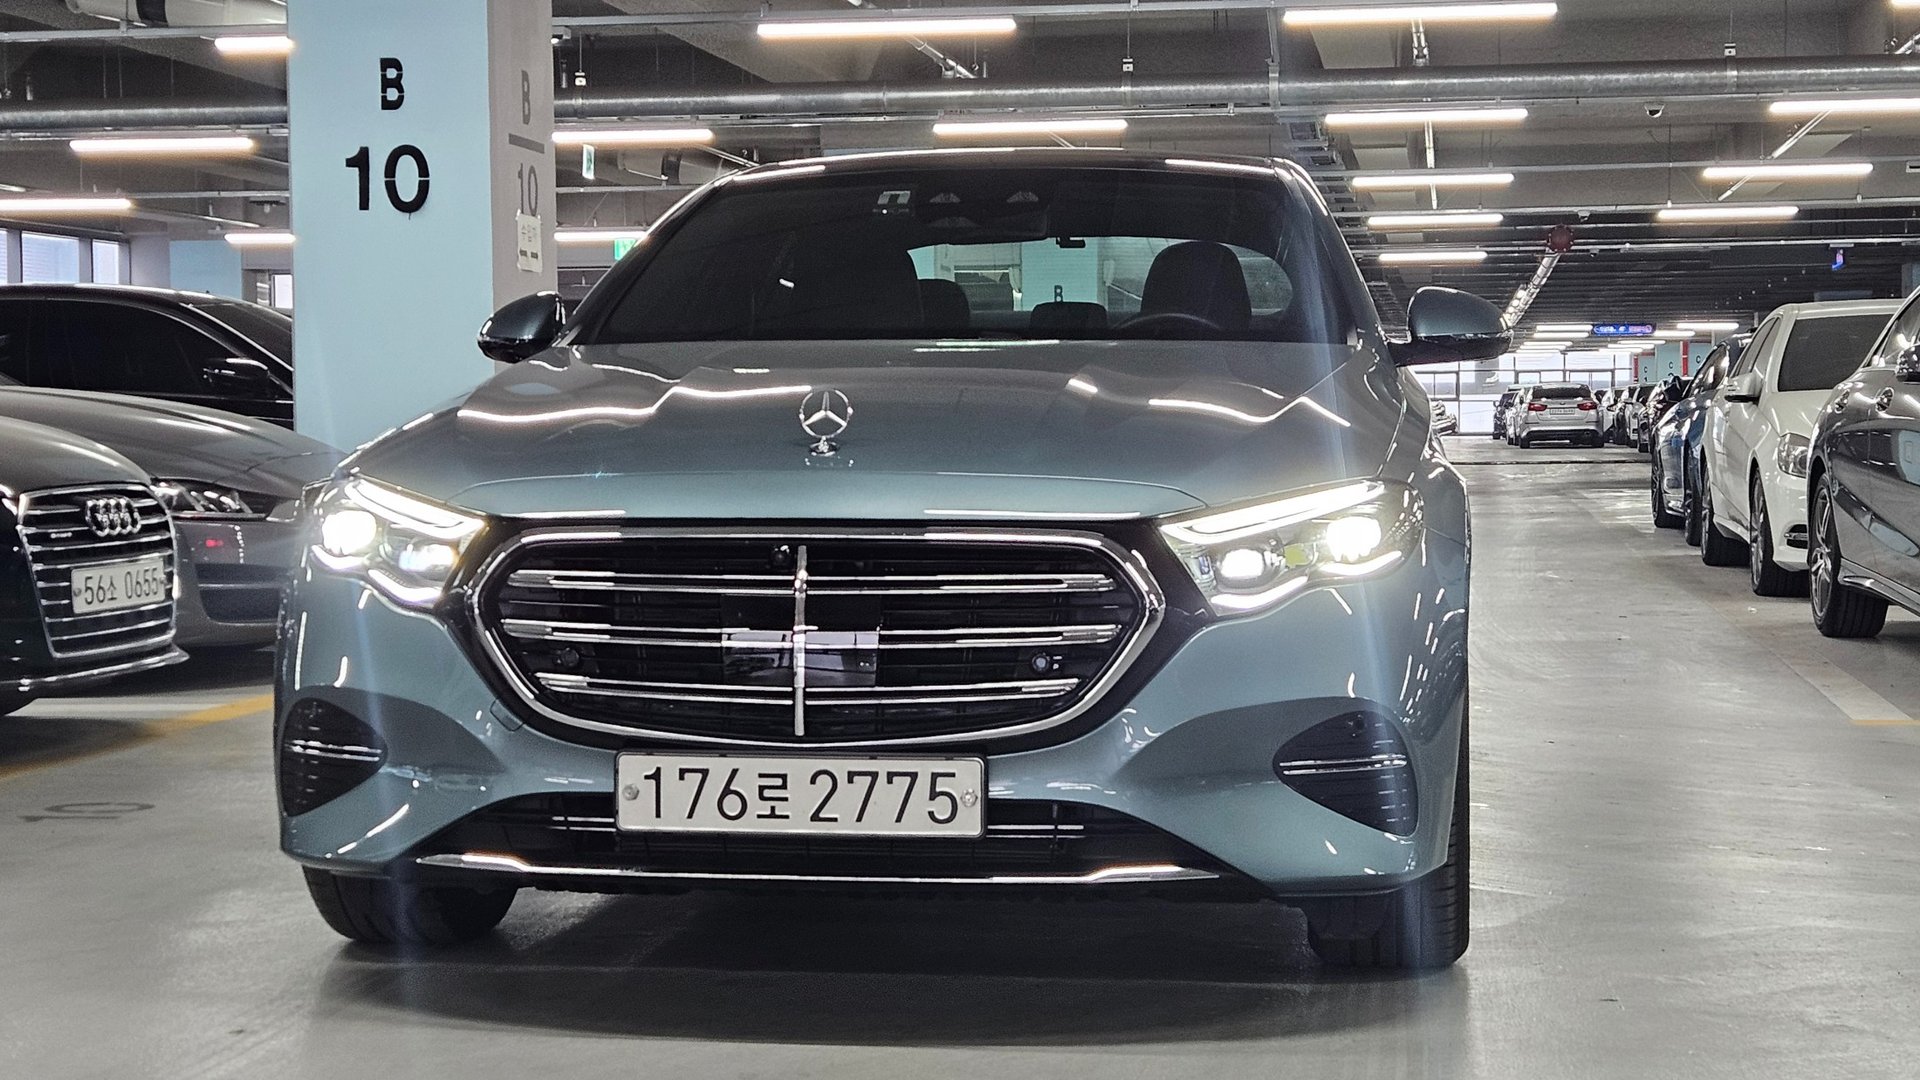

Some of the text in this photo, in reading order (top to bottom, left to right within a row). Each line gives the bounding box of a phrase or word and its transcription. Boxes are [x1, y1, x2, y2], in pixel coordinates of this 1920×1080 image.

[379, 57, 405, 110] B
[521, 70, 531, 125] B
[345, 144, 430, 214] 10
[518, 163, 538, 216] 10
[1668, 361, 1674, 369] C
[84, 567, 158, 605] 56소 0655
[643, 765, 958, 825] 176로 2775
